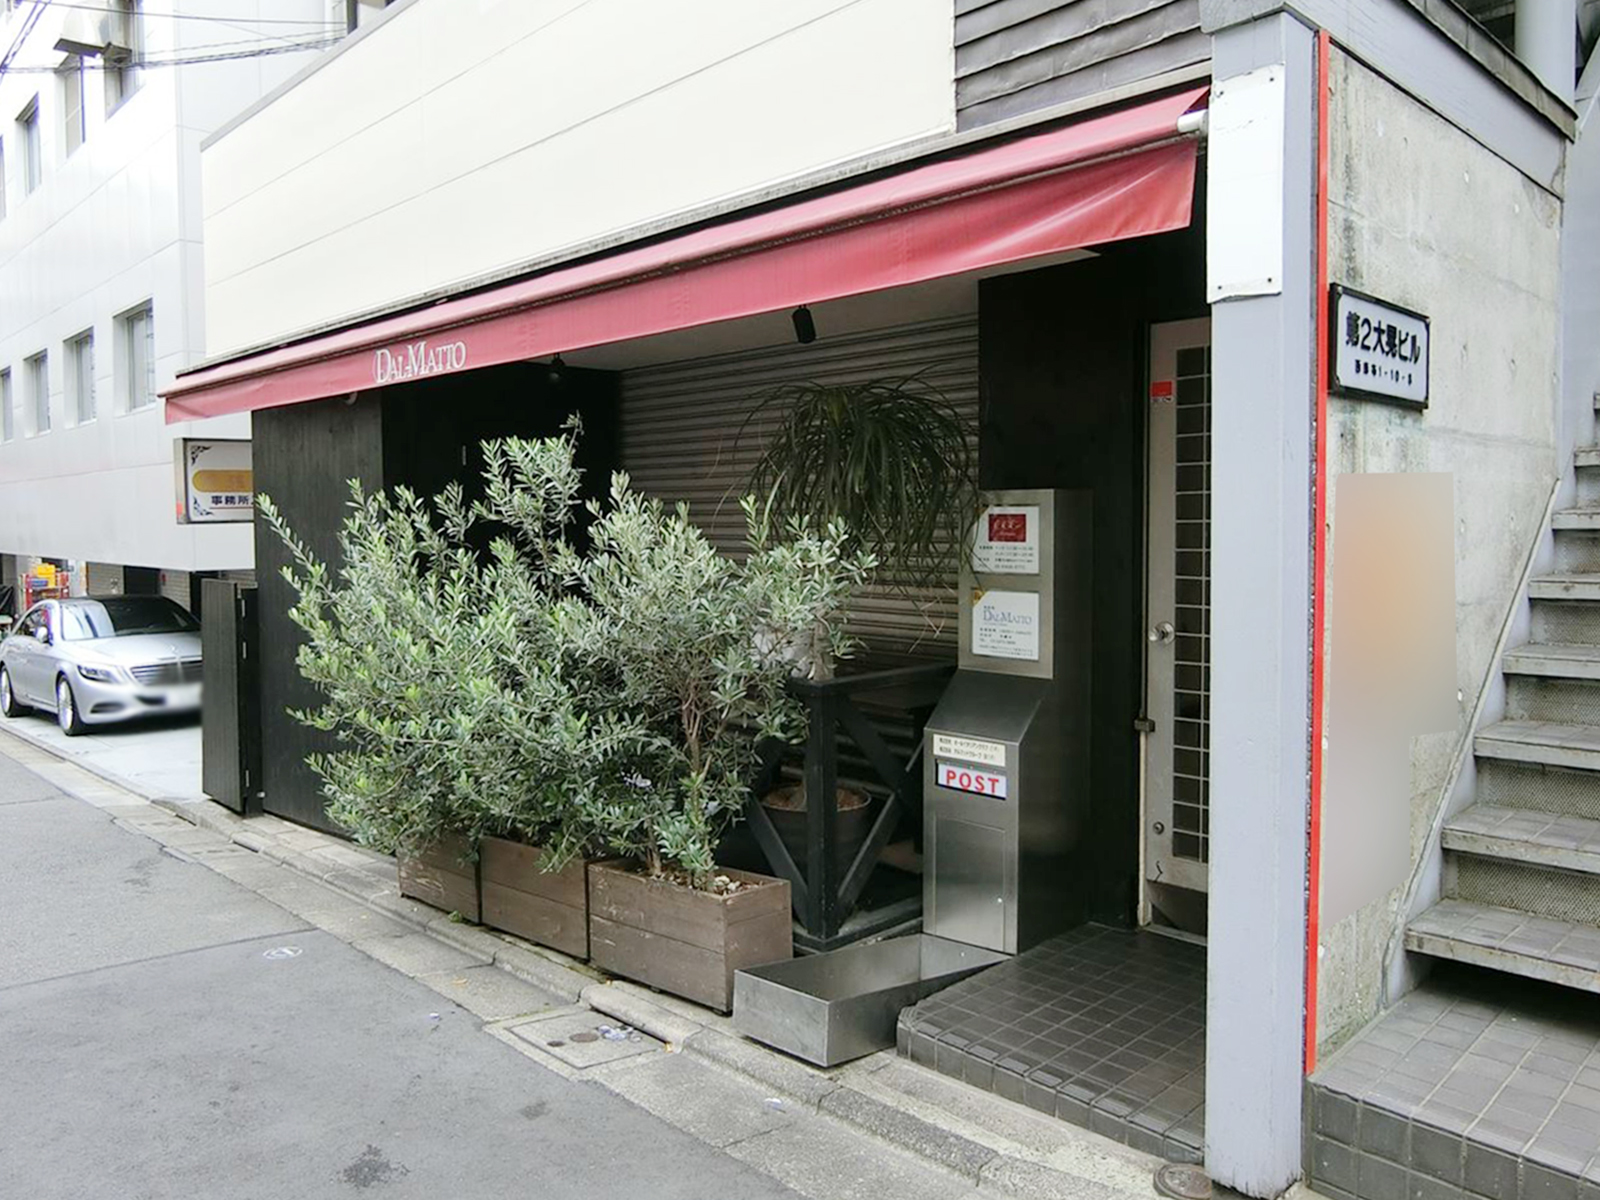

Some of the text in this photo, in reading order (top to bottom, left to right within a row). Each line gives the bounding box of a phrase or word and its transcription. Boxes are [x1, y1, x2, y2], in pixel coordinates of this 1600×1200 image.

[211, 495, 254, 506] 事務所
[946, 769, 999, 794] POST
